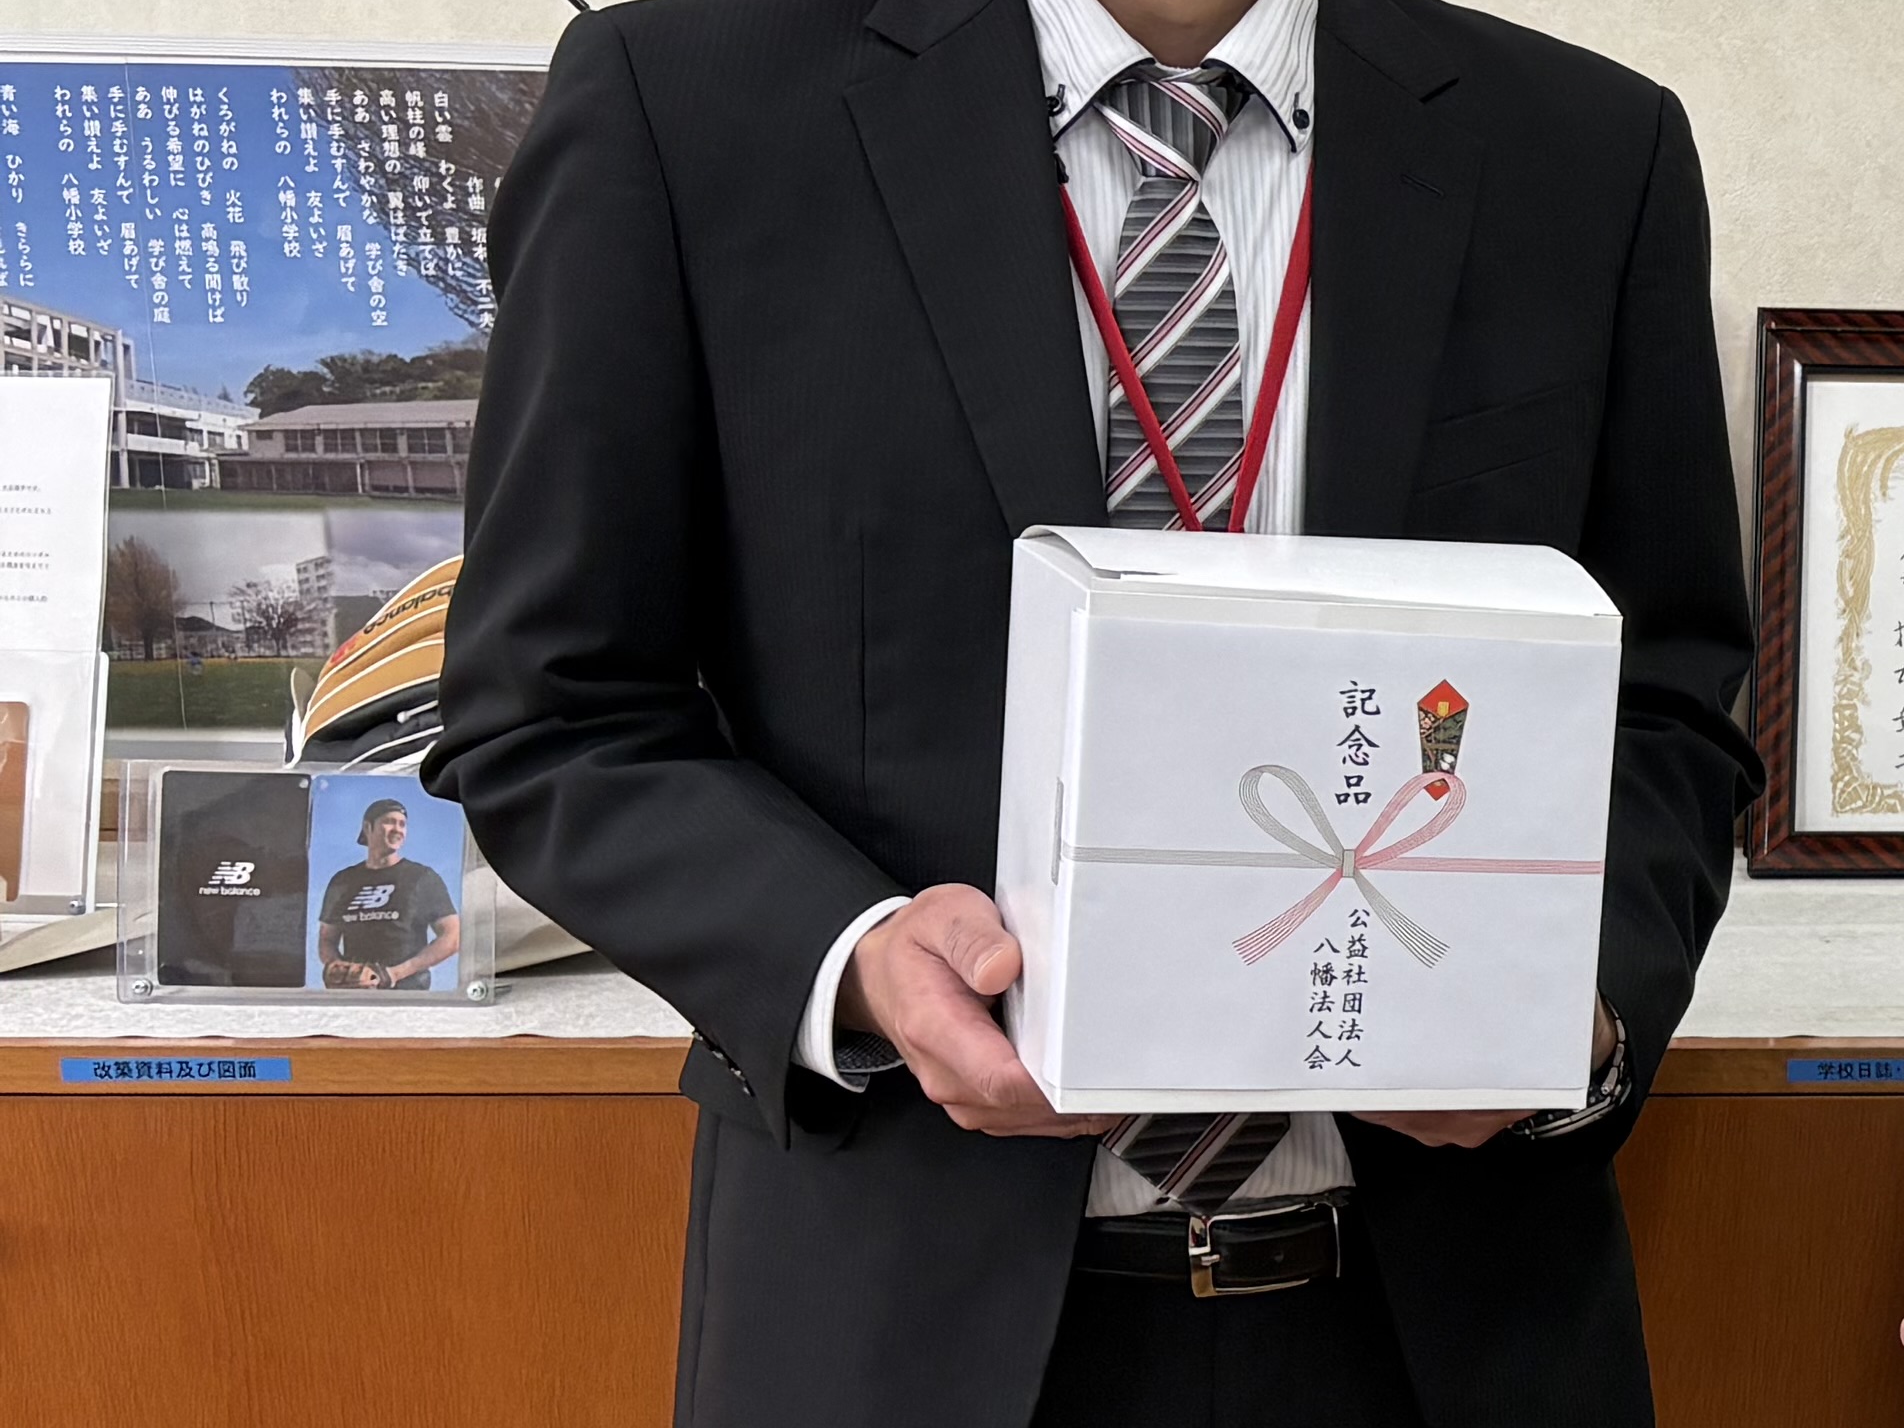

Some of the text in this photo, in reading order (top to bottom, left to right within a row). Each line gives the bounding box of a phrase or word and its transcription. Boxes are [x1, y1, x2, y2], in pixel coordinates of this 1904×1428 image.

[54, 85, 86, 256] われらの 八幡小学校
[188, 87, 214, 206] はがねのひびき
[217, 86, 239, 171] くろがねの
[270, 88, 301, 258] われらの 八幡小学校
[439, 160, 457, 210] わくよ
[6, 154, 24, 204] ひかり
[15, 222, 35, 288] きららに
[90, 188, 112, 256] 友よいざ
[135, 86, 171, 324] ああ うるわしい 学び舎の庭
[172, 208, 194, 289] 心は燃えて
[226, 189, 245, 223] 火花
[306, 190, 328, 258] 友よいざ
[353, 89, 388, 326] ああ さわやかな 学び舎の空
[1334, 679, 1383, 809] 記念品
[1302, 936, 1342, 1072] 八幡法人会
[1336, 906, 1372, 1070] 公益社団法人
[92, 1058, 258, 1081] 改築資料及び図面
